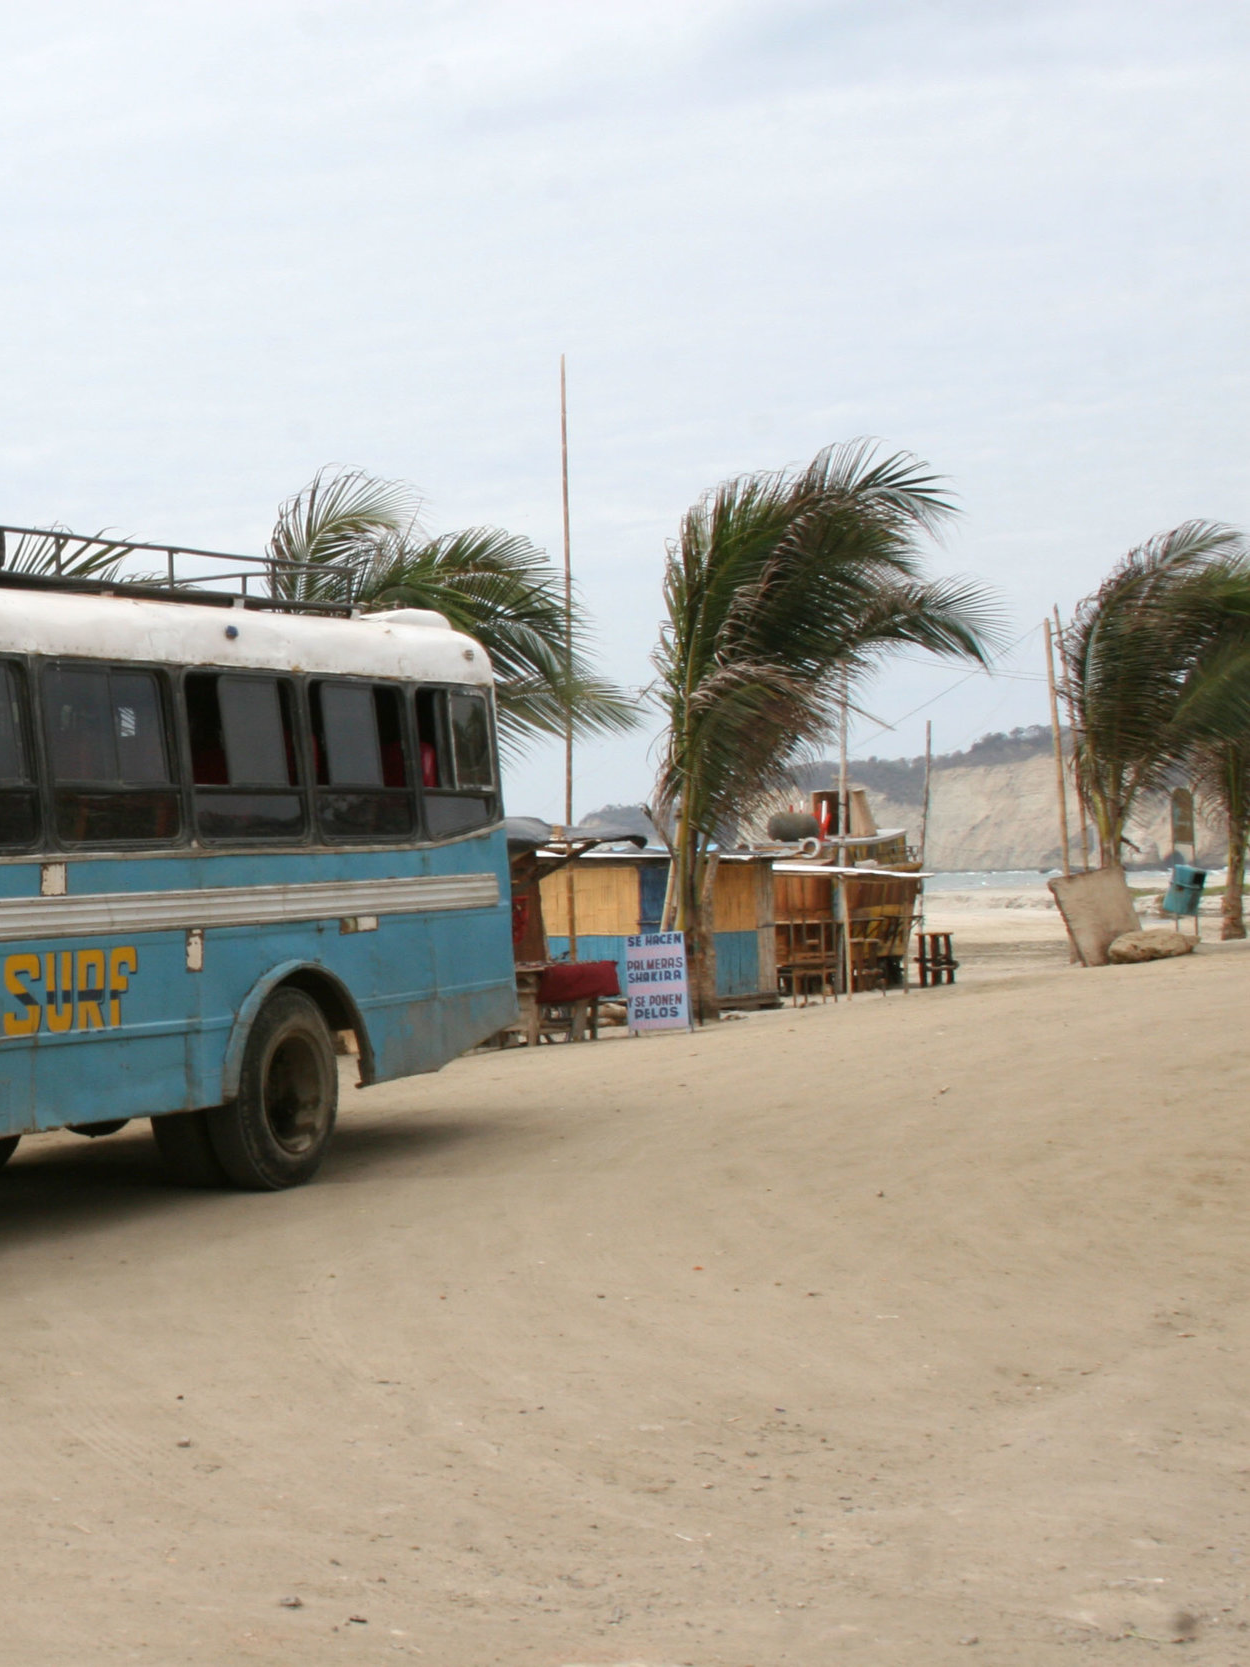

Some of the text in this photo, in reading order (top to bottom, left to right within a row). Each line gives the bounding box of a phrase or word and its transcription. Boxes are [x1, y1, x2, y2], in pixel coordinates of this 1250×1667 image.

[627, 932, 682, 948] SE HACEN
[627, 956, 683, 972] PALMERAS
[628, 969, 682, 984] SHAKIRA
[3, 945, 137, 1037] SURF
[635, 994, 646, 1008] SE
[649, 993, 683, 1006] PONEN
[634, 1006, 679, 1020] PELOS
